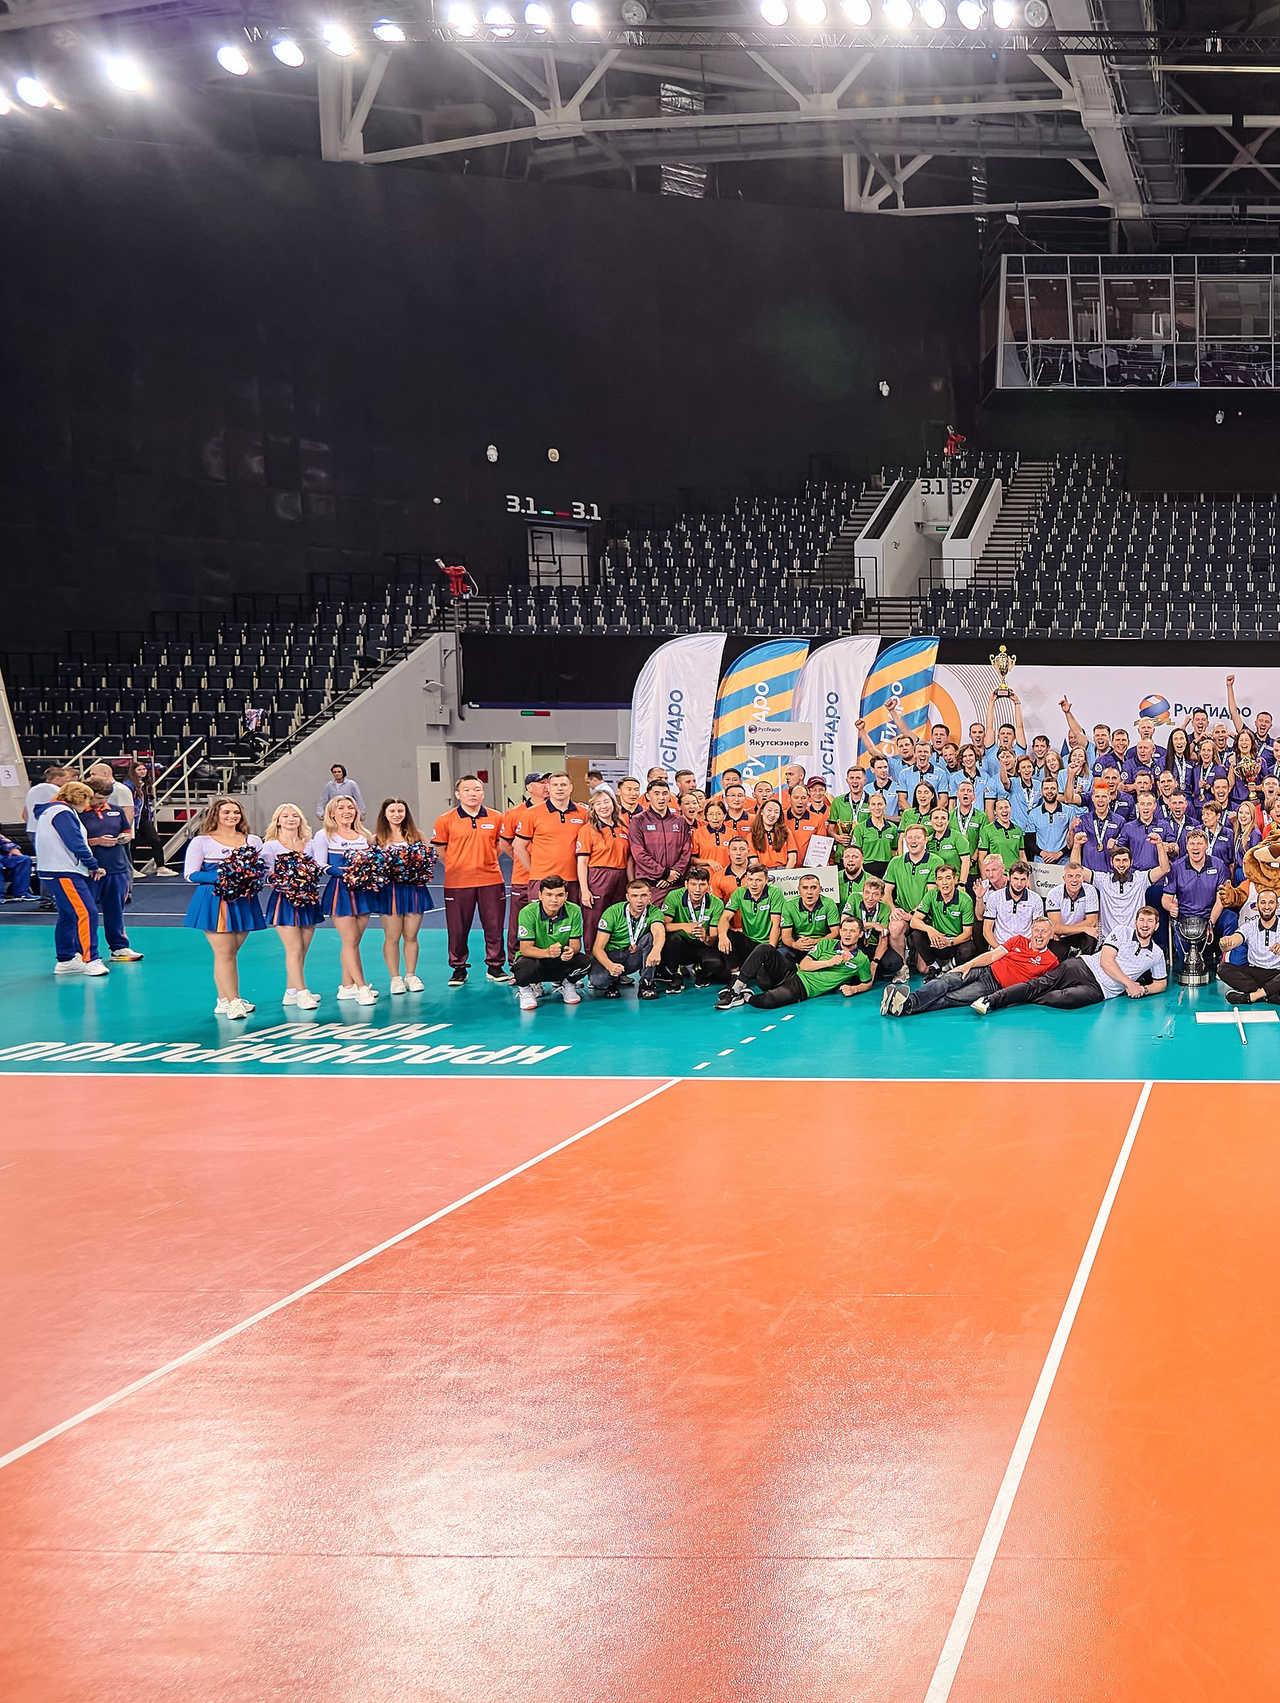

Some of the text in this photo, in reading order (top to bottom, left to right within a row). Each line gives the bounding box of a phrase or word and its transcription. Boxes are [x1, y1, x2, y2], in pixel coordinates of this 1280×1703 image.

[920, 479, 945, 495] 3.1
[506, 494, 602, 521] 3.1 3.1
[659, 689, 686, 787] усГидро
[749, 739, 810, 748] Якутскэнерго
[4, 769, 12, 780] 3
[228, 1022, 453, 1043] КРАЙ
